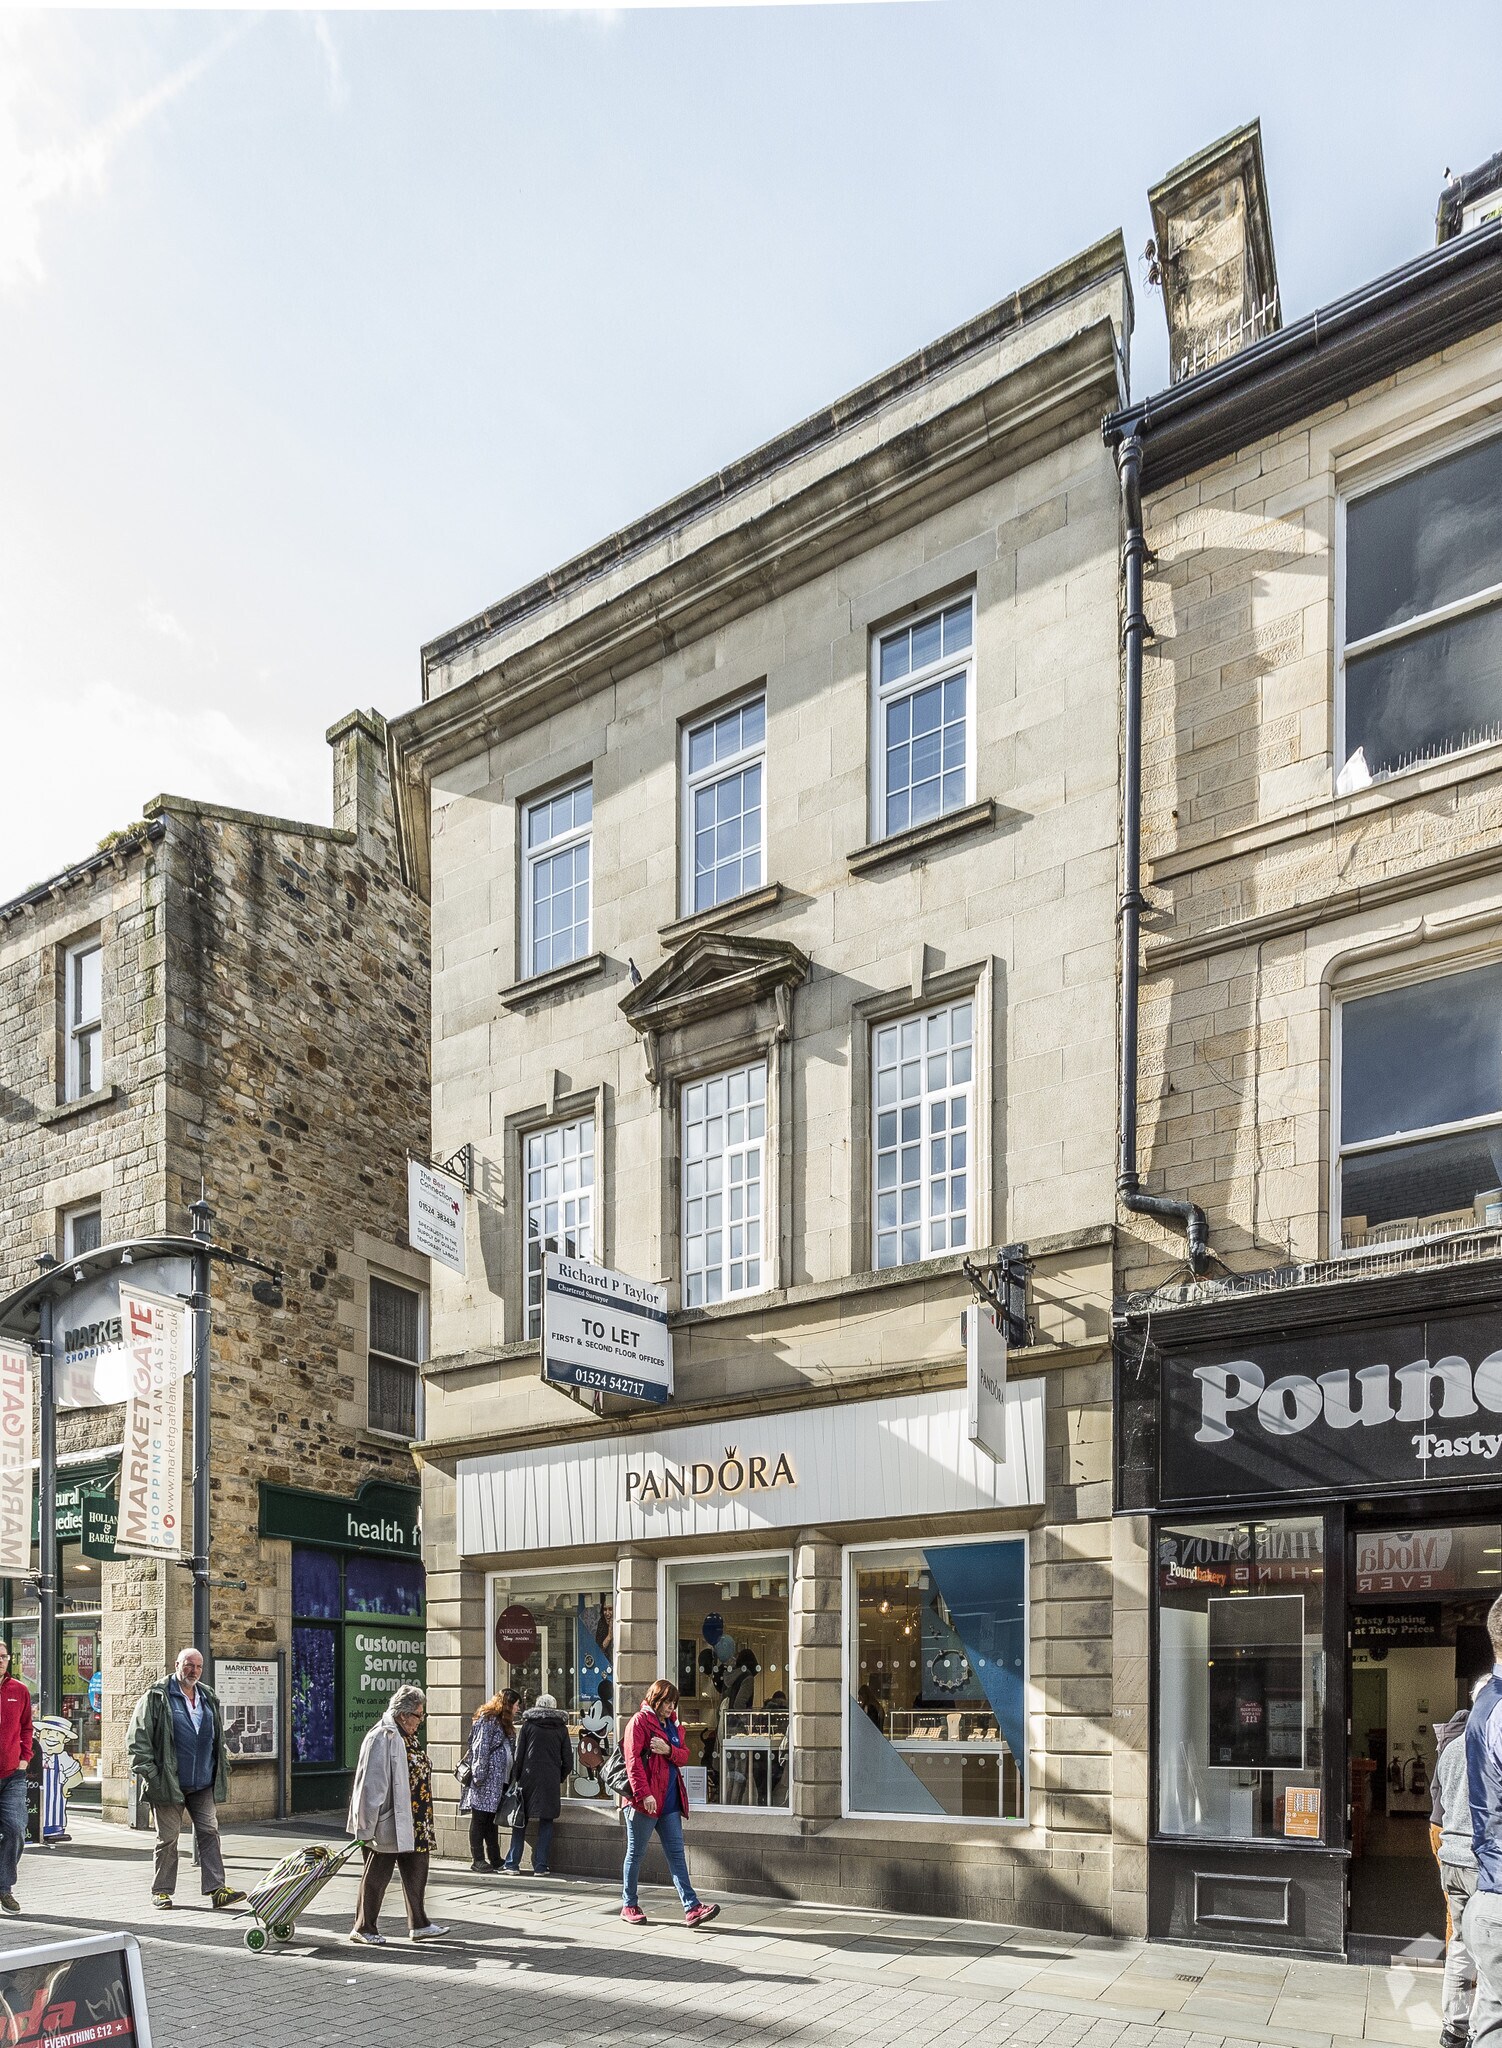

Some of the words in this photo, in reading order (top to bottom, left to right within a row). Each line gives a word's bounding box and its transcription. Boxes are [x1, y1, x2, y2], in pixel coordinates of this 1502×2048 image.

[420, 1170, 431, 1182] The
[432, 1178, 446, 1190] Best
[420, 1178, 454, 1203] Connection
[418, 1201, 434, 1215] 01524
[436, 1210, 456, 1228] 383438
[417, 1235, 441, 1252] TEMPORARY
[418, 1228, 433, 1240] SUPPLY
[449, 1238, 457, 1247] THE
[558, 1262, 608, 1288] Richard
[612, 1279, 620, 1291] P
[623, 1284, 659, 1304] Taylor
[558, 1283, 585, 1297] Chartered
[585, 1290, 608, 1303] Surveyor
[65, 1316, 122, 1352] MARKE
[582, 1318, 605, 1338] TO
[611, 1326, 640, 1348] LET
[66, 1346, 112, 1364] SHOPPING
[552, 1332, 574, 1344] FIRST
[577, 1338, 583, 1346] &
[585, 1340, 612, 1353] SECOND
[615, 1348, 636, 1359] FLOOR
[639, 1354, 665, 1366] OFFICES
[154, 1308, 164, 1427] LANCASTER
[576, 1368, 607, 1387] 01524
[609, 1377, 644, 1396] 542717
[980, 1368, 1005, 1407] PANDORA
[126, 1301, 152, 1541] MARKETGATE
[162, 1311, 178, 1512] www.marketgatelancaster.co.uk
[1412, 1432, 1502, 1458] Tasty
[626, 1448, 795, 1502] PANDORA
[56, 1488, 79, 1506] tural
[150, 1439, 162, 1544] SHOPPING
[56, 1512, 82, 1531] edies
[89, 1512, 118, 1524] HOLLAN
[88, 1532, 116, 1544] BARRE
[104, 1524, 111, 1534] &
[347, 1513, 404, 1544] health
[412, 1524, 420, 1546] f
[1170, 1562, 1226, 1587] Poundbakery
[1354, 1616, 1384, 1625] Tasty
[1387, 1615, 1426, 1624] Baking
[1354, 1627, 1366, 1635] at
[1369, 1626, 1398, 1635] Tasty
[1401, 1624, 1435, 1633] Prices
[356, 1634, 425, 1654] Customer
[63, 1651, 76, 1666] ter
[79, 1644, 93, 1656] Half
[79, 1656, 93, 1666] Price
[364, 1654, 417, 1672] Service
[63, 1674, 76, 1685] ess
[349, 1710, 363, 1720] right
[44, 2028, 96, 2048] EVERYTHING
[97, 2024, 112, 2038] £12
